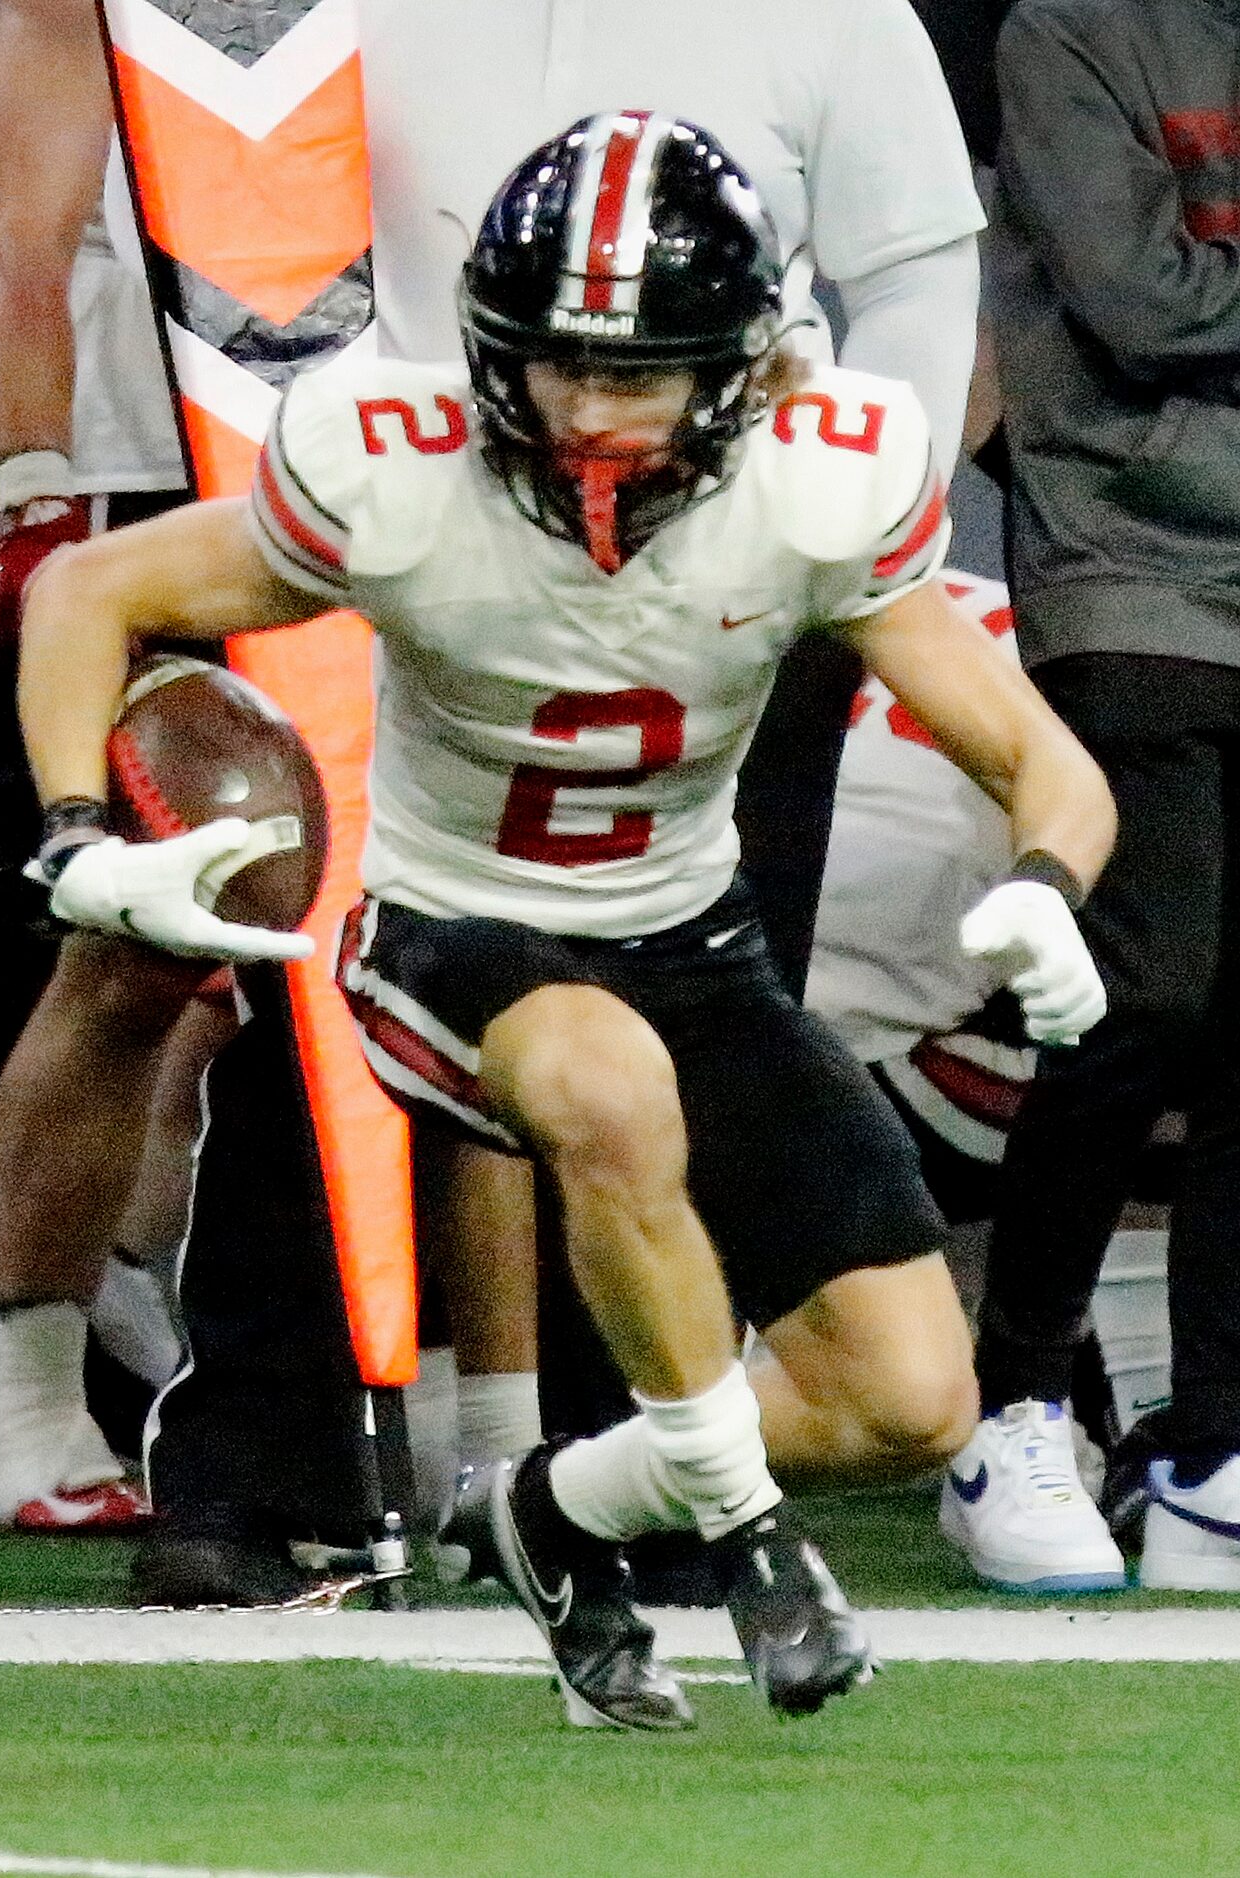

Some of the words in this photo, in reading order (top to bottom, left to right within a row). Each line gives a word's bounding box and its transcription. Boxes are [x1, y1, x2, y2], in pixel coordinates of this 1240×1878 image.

[356, 394, 469, 455] 2
[772, 392, 887, 455] 2
[496, 686, 687, 868] 2
